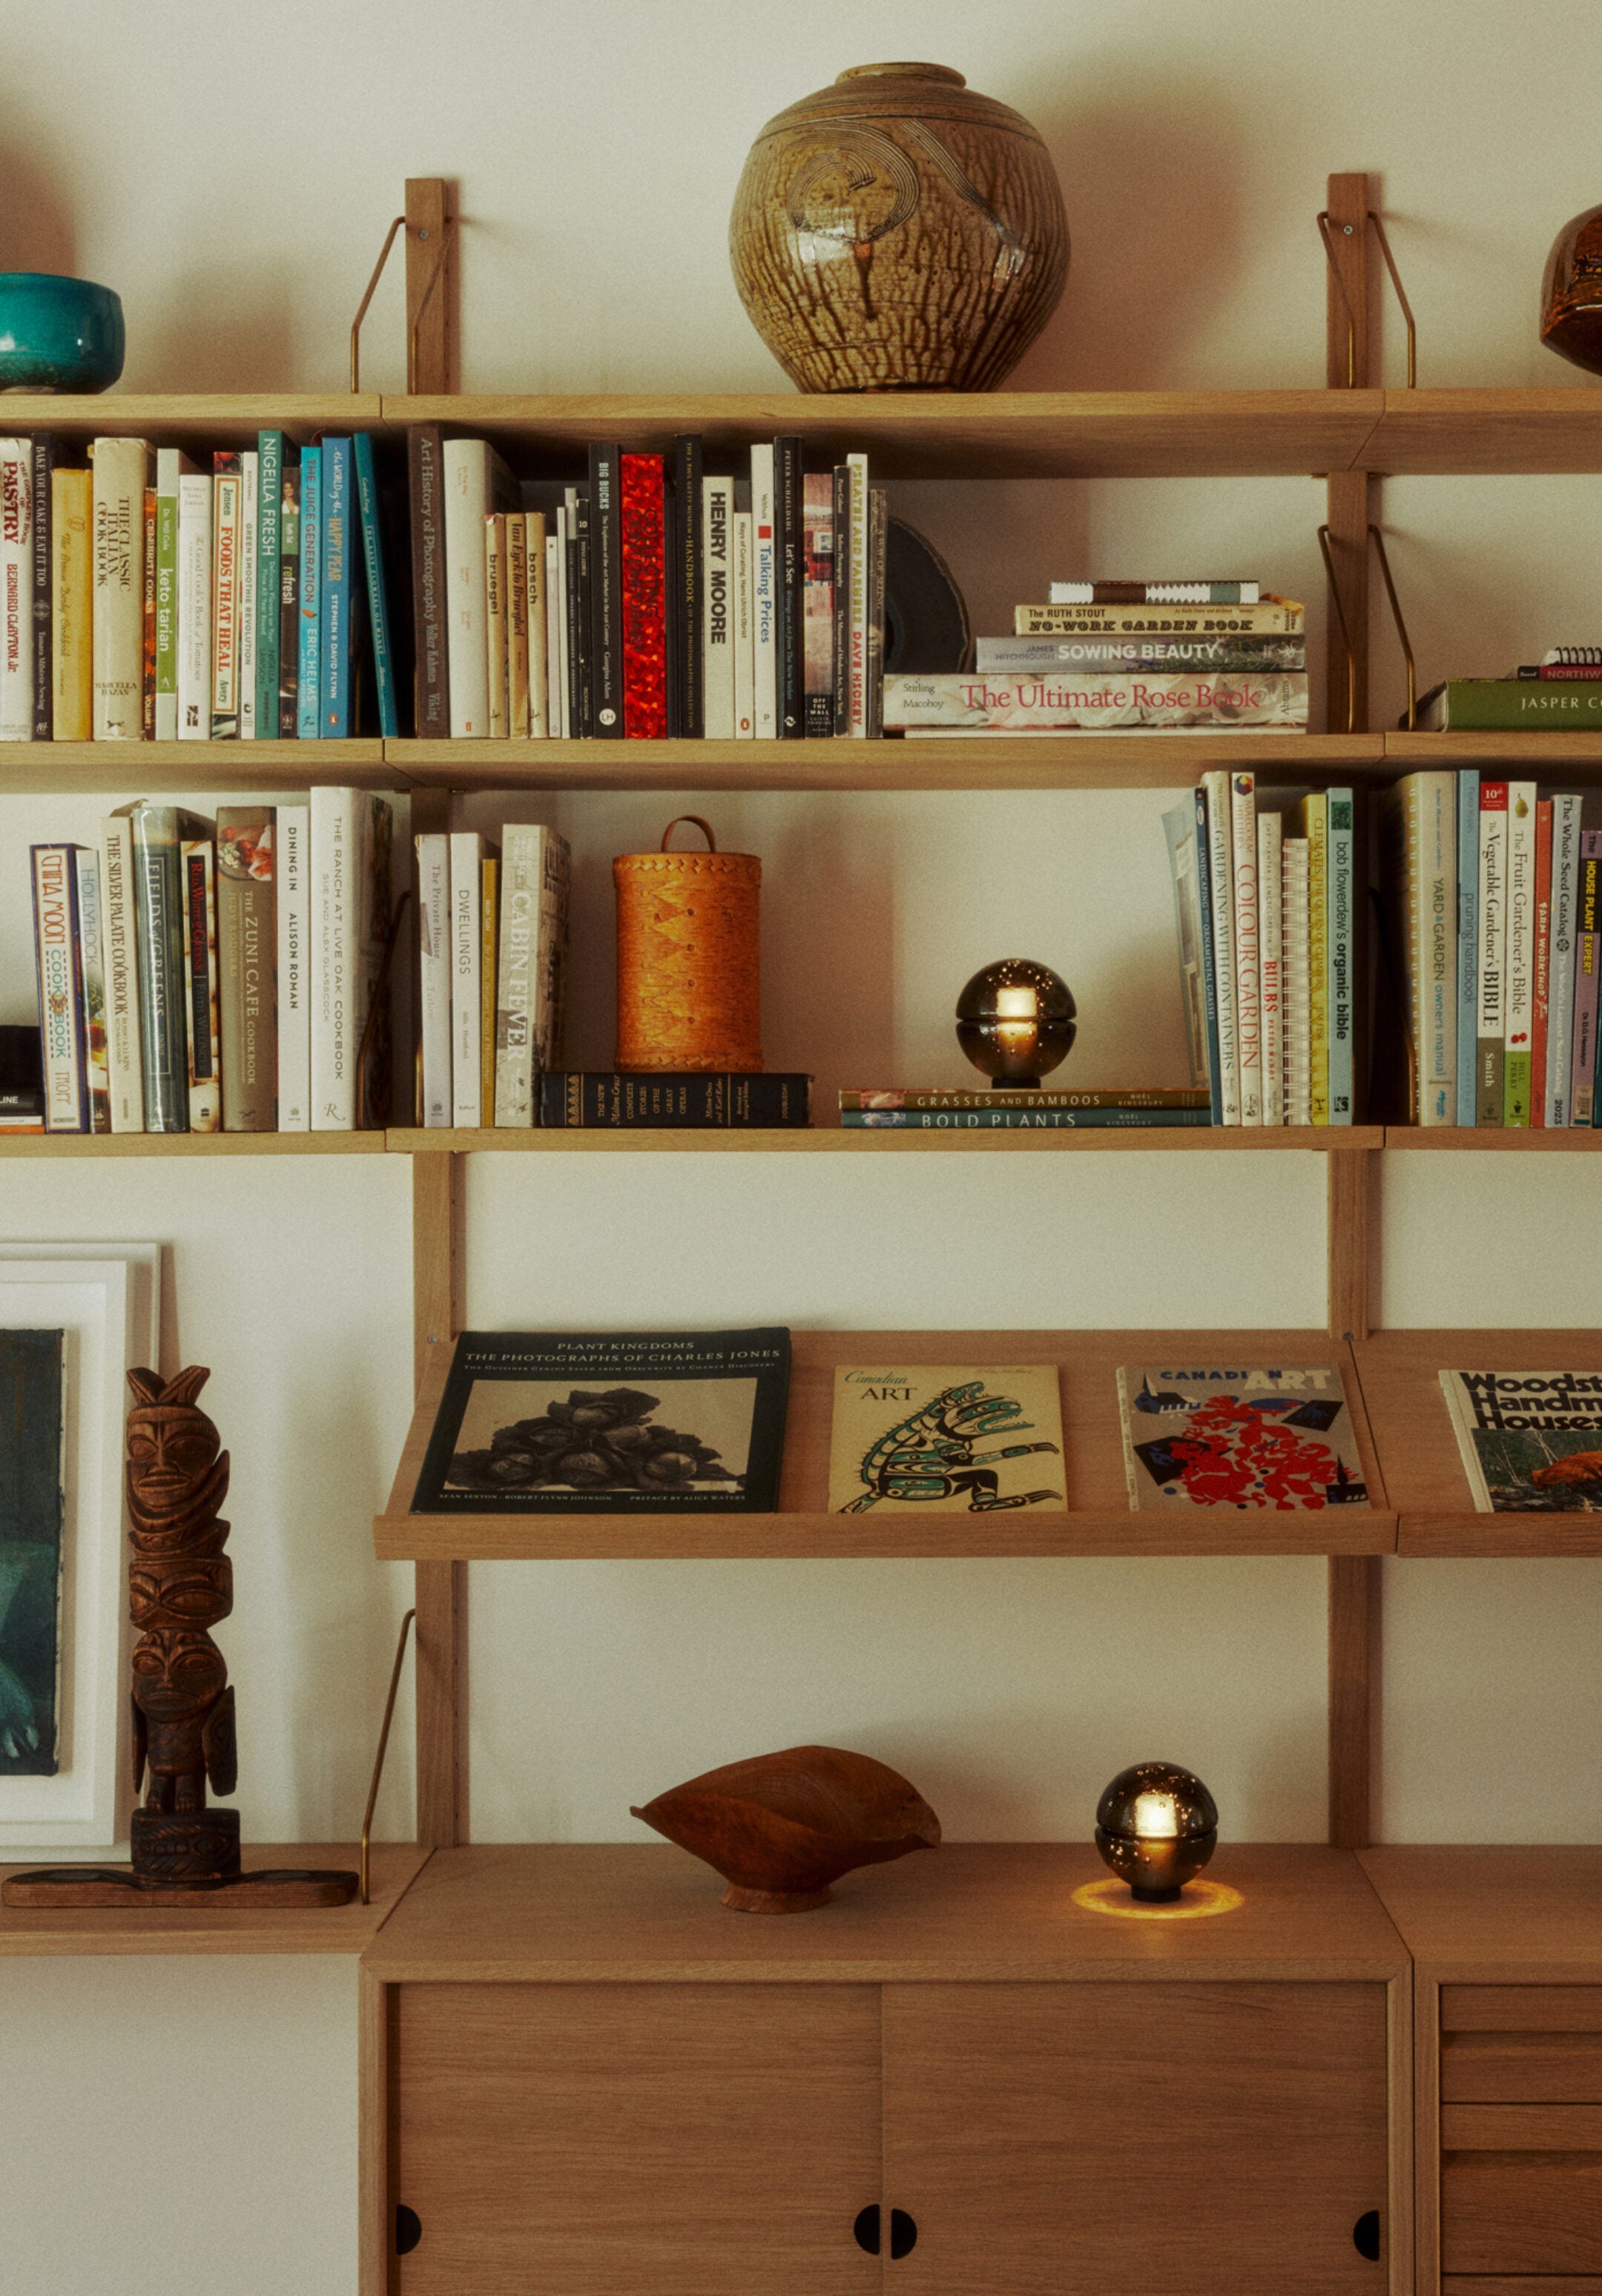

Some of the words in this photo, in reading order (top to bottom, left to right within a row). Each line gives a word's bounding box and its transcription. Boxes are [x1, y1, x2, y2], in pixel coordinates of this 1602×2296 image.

[36, 446, 45, 470] BAKE
[306, 459, 316, 481] THE
[421, 438, 432, 464] Art
[36, 473, 45, 499] YOUR
[263, 439, 276, 503] NIGELLA
[599, 463, 609, 478] BIG
[3, 461, 19, 544] PASTRY
[222, 487, 233, 515] Jensen
[306, 485, 316, 519] JUICE
[421, 466, 434, 516] History
[599, 481, 609, 509] BUCKS
[853, 464, 862, 521] PIRATES
[36, 503, 45, 524] CAKE
[97, 502, 107, 542] COOK
[119, 496, 130, 528] THE
[423, 519, 435, 532] of
[711, 492, 725, 561] HENRY
[36, 536, 46, 553] EAT
[108, 513, 119, 575] ITALIAN
[262, 509, 276, 555] FRESH
[329, 518, 341, 553] HAPPY
[853, 527, 862, 555] AND
[36, 555, 46, 564] IT
[97, 547, 107, 587] BOOK
[119, 530, 131, 593] CLASSIC
[220, 527, 233, 576] FOODS
[305, 524, 315, 603] GENERATION
[329, 555, 341, 581] PEAR
[758, 545, 771, 595] Talking
[785, 544, 795, 565] Let's
[7, 564, 18, 612] BERNARD
[36, 567, 46, 586] TOO
[283, 567, 294, 604] refresh
[423, 535, 436, 620] Photography
[489, 555, 499, 615] bruegel
[529, 552, 538, 604] bosch
[785, 567, 795, 584] See
[853, 561, 862, 624] FARMERS
[220, 580, 232, 622] THAT
[711, 571, 725, 644] MOORE
[1029, 609, 1044, 617] The
[1047, 609, 1072, 617] RUTH
[1076, 609, 1105, 617] STOUT
[761, 601, 771, 643] Prices
[1029, 620, 1116, 632] NO-WORK
[1122, 621, 1198, 630] GARDEN
[1203, 620, 1253, 630] BOOK
[218, 628, 231, 672] HEAL
[306, 628, 317, 657] ERIC
[853, 632, 862, 667] DAVE
[1058, 644, 1139, 659] SOWING
[1143, 644, 1219, 659] BEAUTY
[218, 680, 228, 703] Avery
[306, 661, 317, 702] HELMS
[852, 673, 862, 725] HICKEY
[903, 684, 935, 693] Stirling
[960, 684, 1011, 707] The
[1017, 684, 1126, 708] Ultimate
[1132, 684, 1190, 707] Rose
[1195, 684, 1260, 707] Book
[1281, 681, 1289, 716] Abrams
[903, 699, 944, 710] Macoboy
[1521, 697, 1579, 710] JASPER
[1562, 799, 1572, 820] The
[107, 835, 120, 860] THE
[289, 827, 297, 874] DINING
[1336, 842, 1349, 865] bob
[1514, 831, 1524, 851] The
[1560, 823, 1572, 860] Whole
[1587, 835, 1598, 853] The
[42, 855, 62, 897] CHINA
[109, 862, 122, 900] SILVER
[432, 865, 441, 884] The
[1212, 830, 1229, 921] GARDENING
[1482, 834, 1500, 895] Vegetable
[1514, 854, 1527, 888] Fruit
[1560, 862, 1572, 891] Seed
[1585, 861, 1596, 894] HOUSE
[289, 878, 297, 891] IN
[1433, 878, 1444, 913] YARD
[44, 900, 65, 943] MOON
[81, 869, 97, 966] HOLLYHOCK
[335, 905, 341, 922] AT
[432, 888, 441, 924] Private
[1236, 864, 1256, 962] COLOUR
[1335, 868, 1349, 940] flowerdew's
[1461, 893, 1476, 940] pruning
[1557, 893, 1571, 937] Catalog
[1584, 897, 1596, 931] PLANT
[110, 903, 125, 946] PALATE
[245, 917, 257, 963] ZUNI
[289, 913, 297, 959] ALISON
[433, 928, 441, 959] House
[458, 890, 469, 974] DWELLINGS
[511, 891, 530, 970] CABIN
[1485, 899, 1500, 968] Gardener's
[1512, 893, 1526, 974] Gardener's
[1216, 926, 1230, 967] WITH
[1434, 923, 1446, 981] GARDEN
[1582, 935, 1593, 974] EXPERT
[51, 949, 64, 994] COOK
[113, 949, 128, 1015] COOKBOOK
[290, 963, 298, 1009] ROMAN
[1263, 960, 1277, 1012] BULBS
[1334, 943, 1349, 999] organic
[1464, 943, 1477, 1004] handbook
[1435, 985, 1444, 1029] owners
[1483, 971, 1500, 1027] BIBLE
[1512, 977, 1526, 1015] Bible
[55, 1014, 66, 1058] BOOK
[507, 979, 527, 1061] FEVER
[1219, 971, 1233, 1069] CONTAINERS
[1239, 969, 1259, 1068] GARDEN
[1336, 1004, 1349, 1040] bible
[247, 1021, 256, 1084] COOKBOOK
[1435, 1034, 1446, 1076] manual
[1484, 1052, 1494, 1086] Smith
[917, 1097, 992, 1106] GRASSES
[1028, 1095, 1100, 1105] BAMBOOS
[1554, 1099, 1563, 1125] 2023
[923, 1115, 978, 1127] BOLD
[992, 1115, 1075, 1127] PLANTS
[502, 1353, 619, 1362] PHOTOGRAPHS
[648, 1352, 724, 1361] CHARLES
[731, 1350, 780, 1359] JONES
[558, 1342, 605, 1350] PLANT
[610, 1341, 694, 1350] KINGDOMS
[845, 1370, 909, 1385] Canadian
[860, 1387, 917, 1400] ART
[1244, 1370, 1331, 1390] ART
